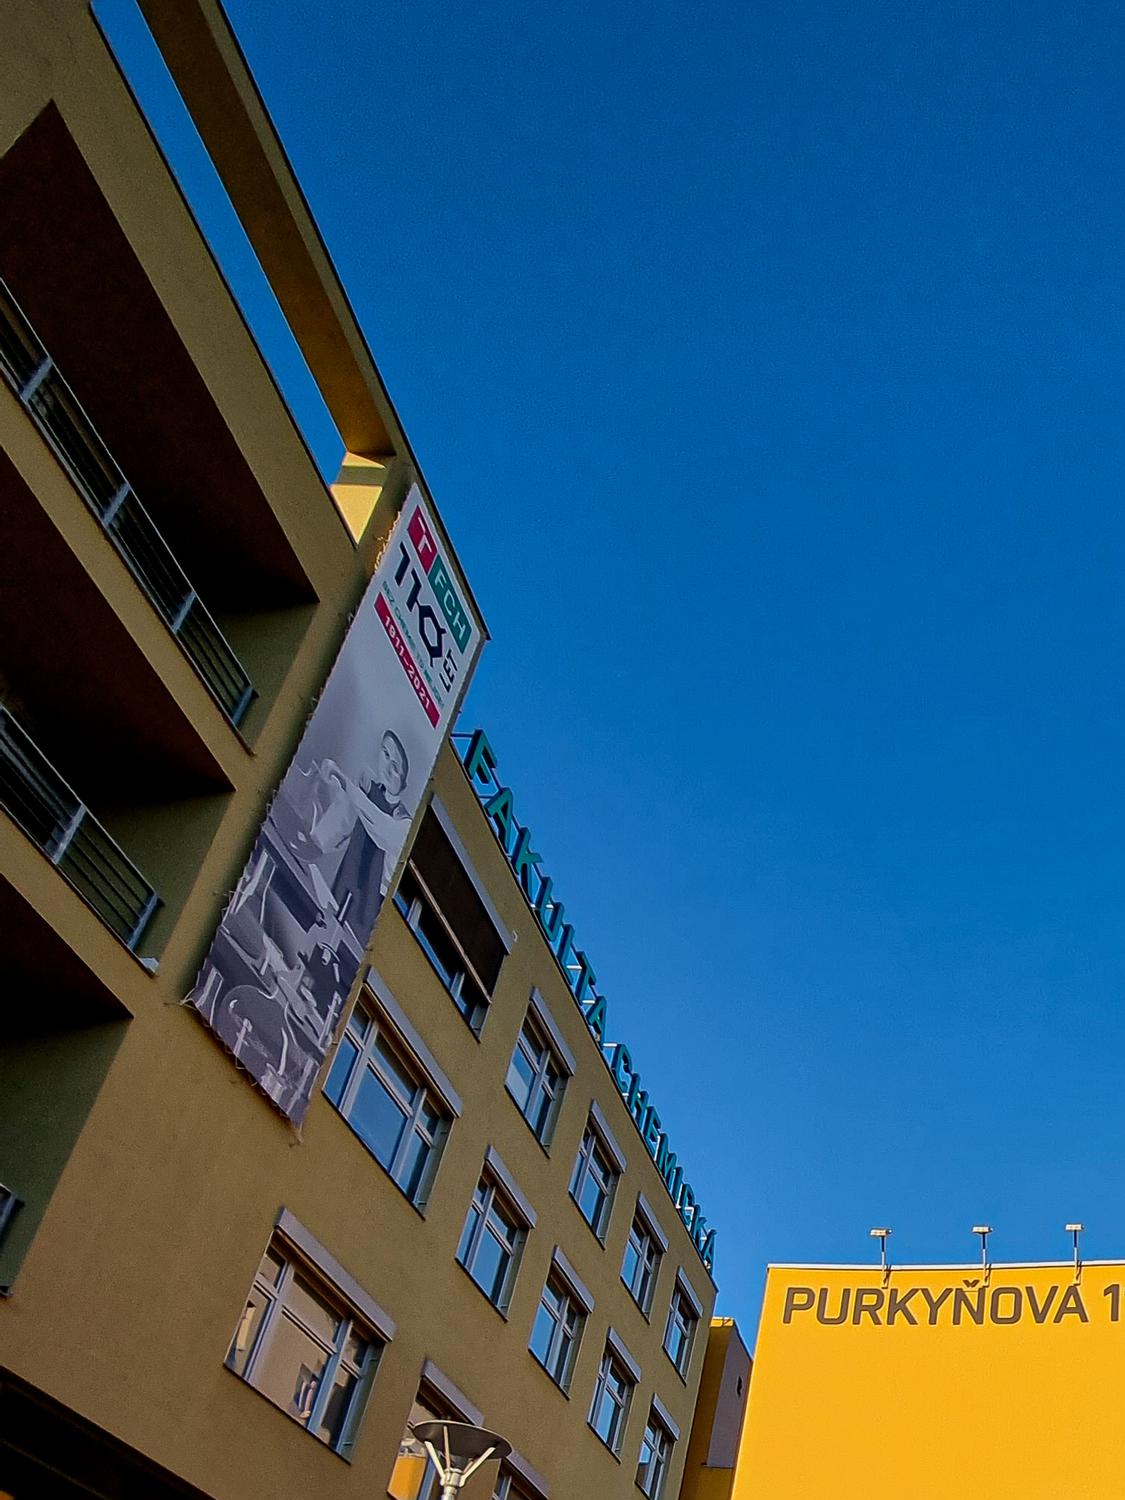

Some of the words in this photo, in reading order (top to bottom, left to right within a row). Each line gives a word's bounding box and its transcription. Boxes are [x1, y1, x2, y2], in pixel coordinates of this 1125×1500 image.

[434, 569, 467, 641] FCH
[439, 648, 458, 693] LET
[463, 727, 608, 1041] FAKULTA
